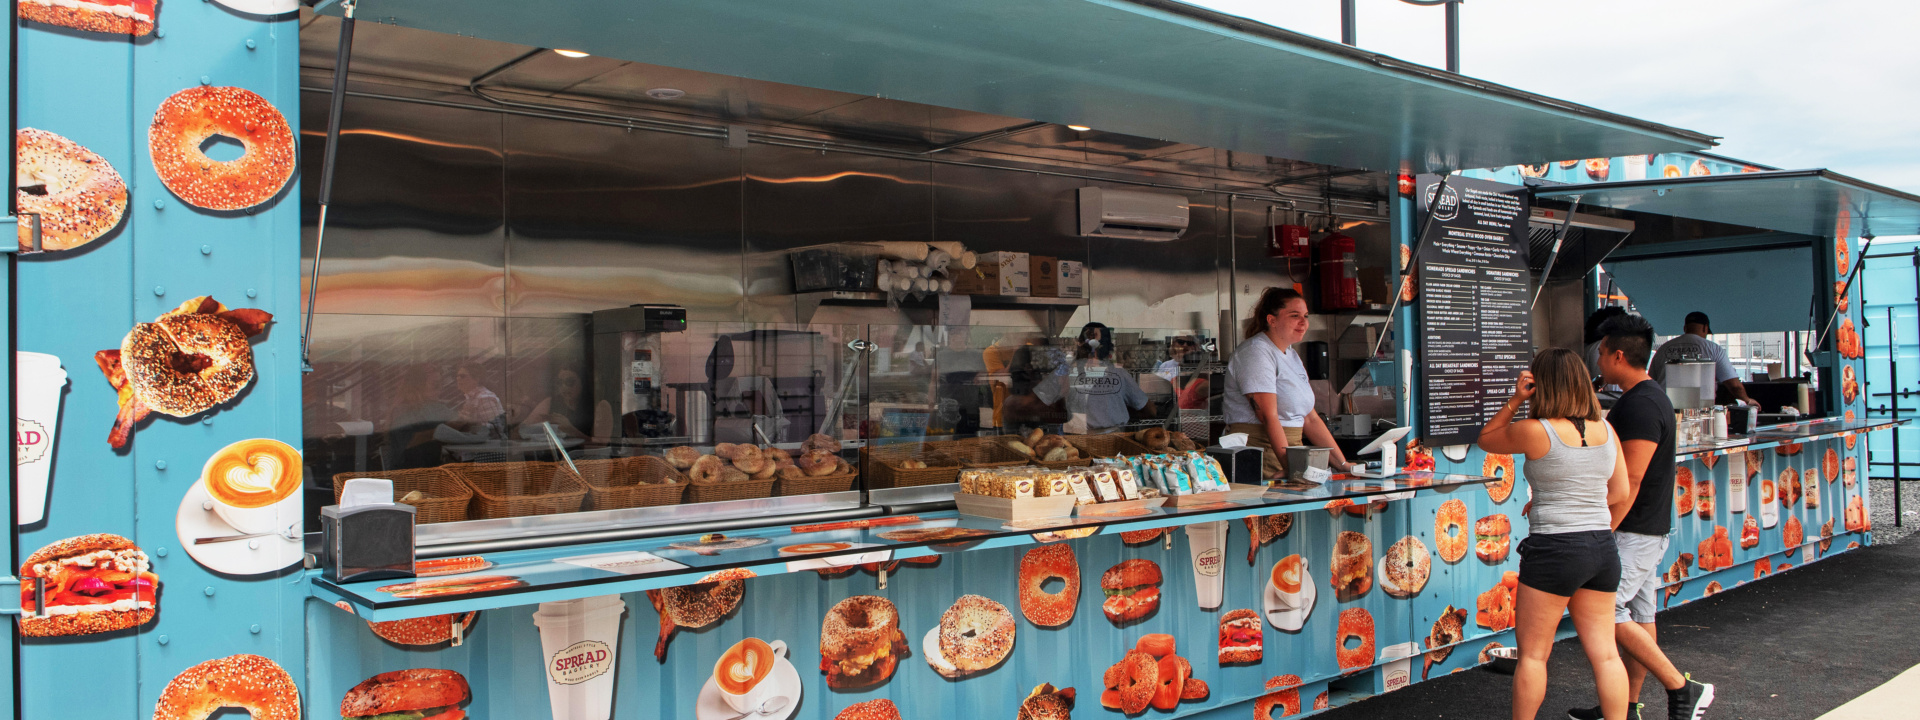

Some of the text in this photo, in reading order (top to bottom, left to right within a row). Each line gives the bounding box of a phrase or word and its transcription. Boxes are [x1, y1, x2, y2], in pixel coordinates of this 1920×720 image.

[1001, 254, 1016, 268] SYSCO
[556, 650, 606, 671] SPREAD
[563, 663, 600, 675] BAGELRY
[1387, 676, 1407, 687] SPREAD
